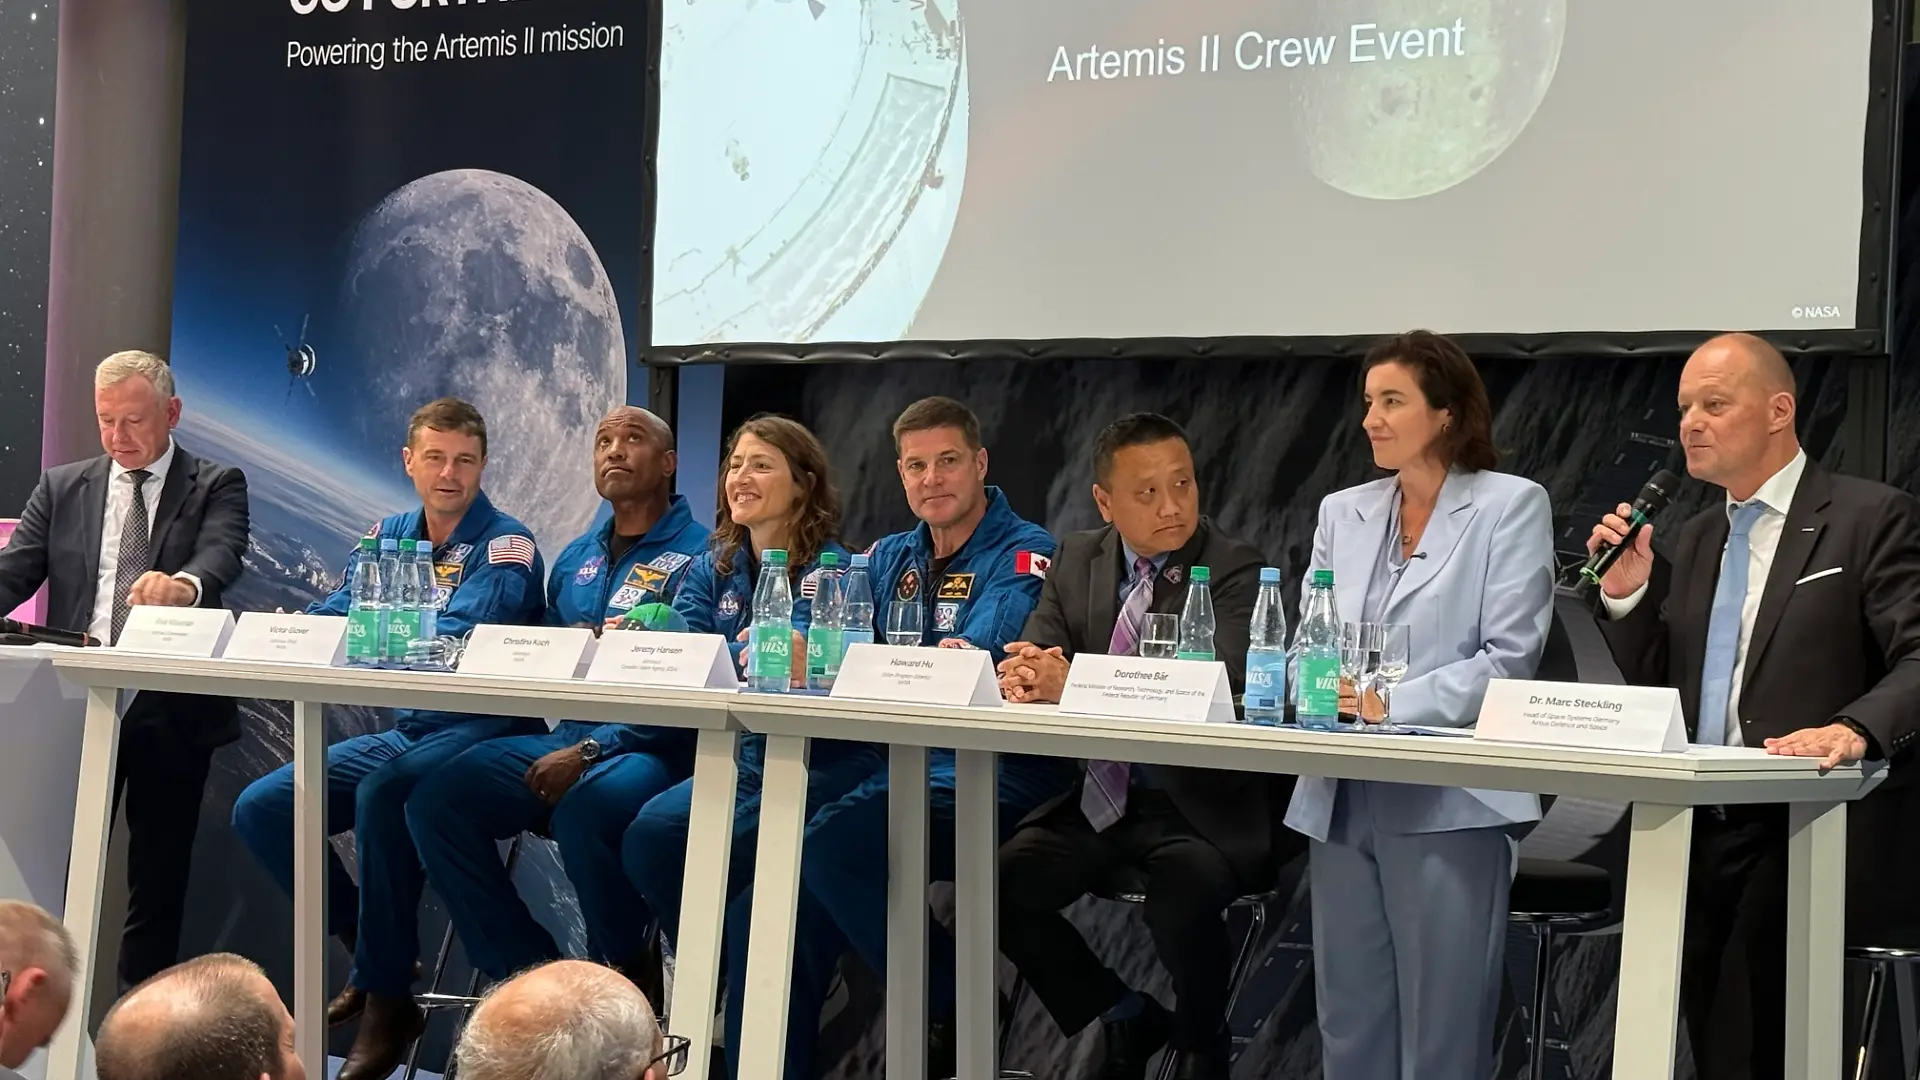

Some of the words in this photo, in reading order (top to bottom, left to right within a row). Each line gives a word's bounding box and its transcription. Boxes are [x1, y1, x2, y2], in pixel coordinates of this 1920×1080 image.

[287, 38, 385, 71] Powering
[392, 36, 428, 63] the
[434, 29, 517, 61] Artemis
[524, 27, 534, 55] II
[541, 21, 624, 53] mission
[1047, 38, 1185, 82] Artemis
[1200, 34, 1220, 72] II
[1234, 30, 1337, 70] Crew
[1349, 17, 1466, 63] Event
[1805, 305, 1841, 318] NASA
[890, 658, 921, 667] Howard
[920, 660, 934, 669] Hu
[1114, 669, 1153, 680] Dorothee
[1153, 670, 1169, 681] Bär
[1529, 695, 1544, 704] Dr.
[1545, 696, 1572, 707] Marc
[1573, 698, 1623, 712] Steckling
